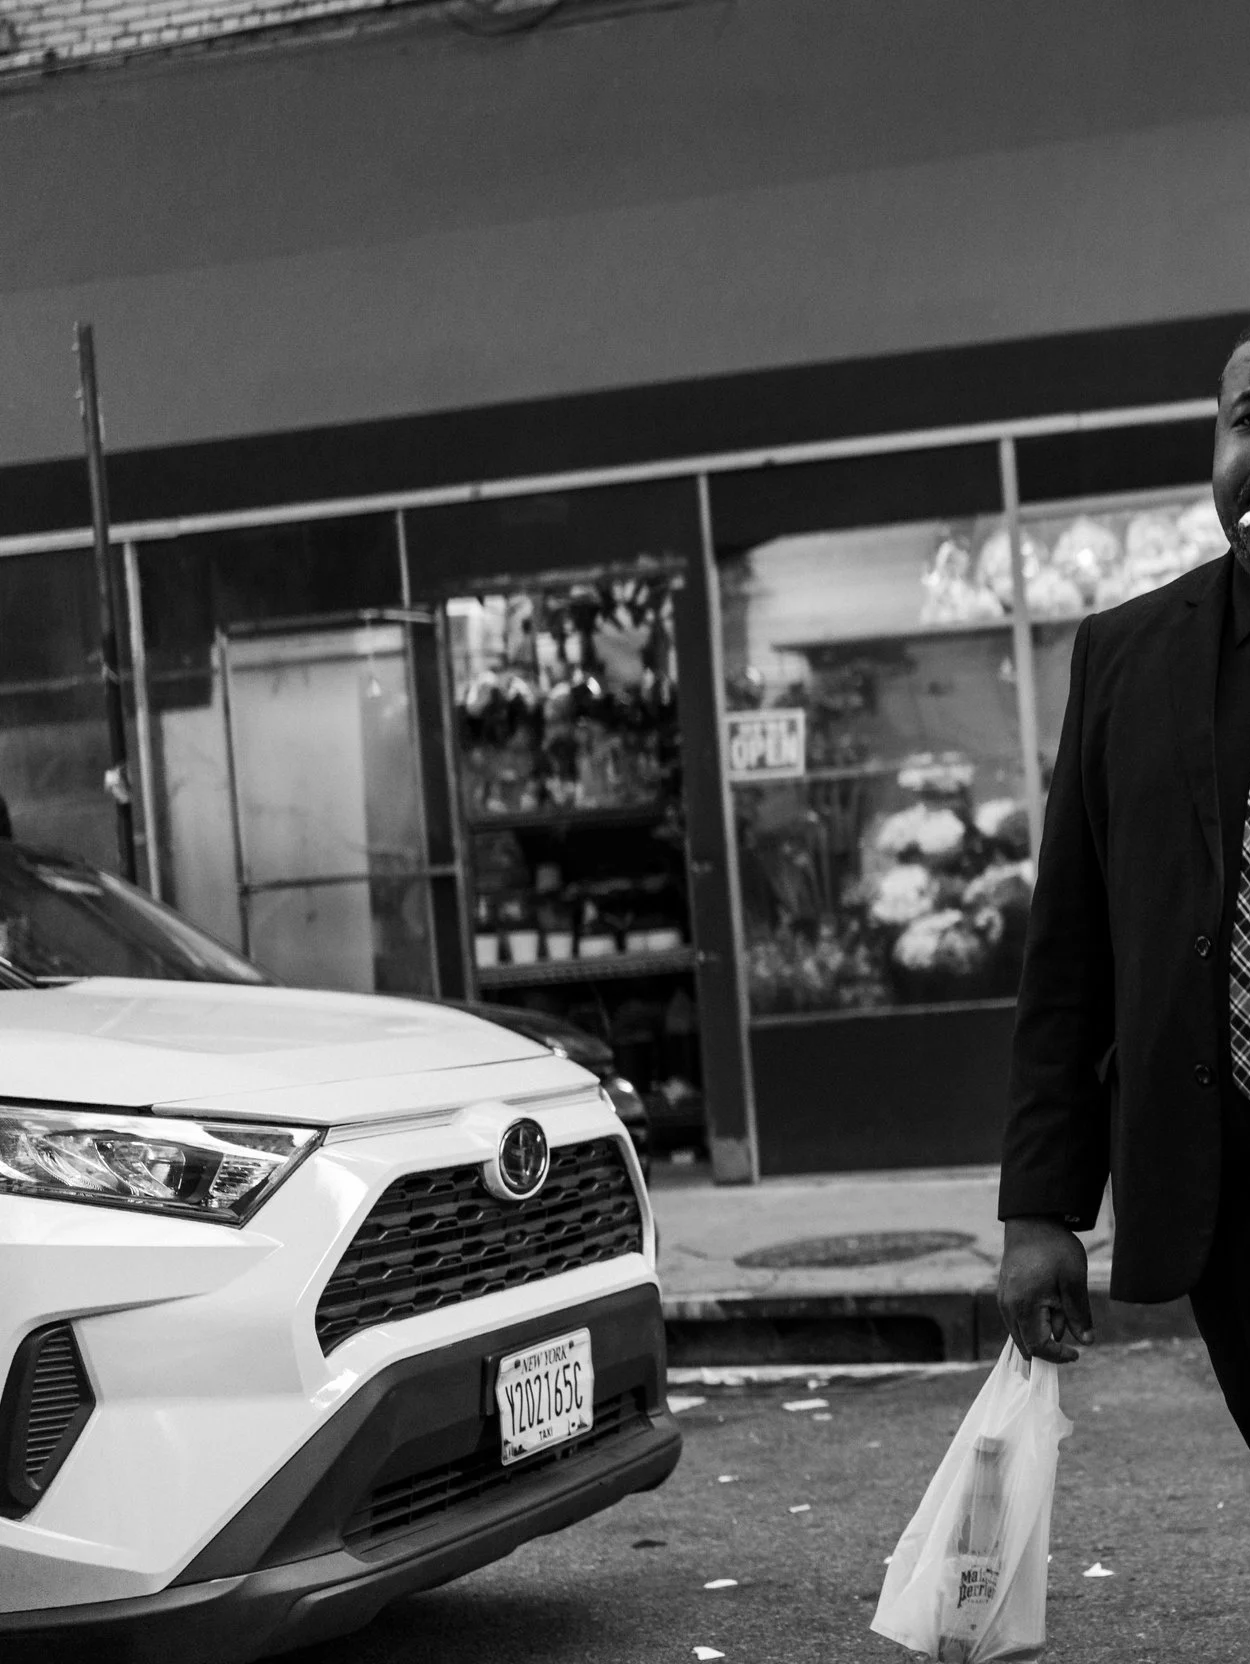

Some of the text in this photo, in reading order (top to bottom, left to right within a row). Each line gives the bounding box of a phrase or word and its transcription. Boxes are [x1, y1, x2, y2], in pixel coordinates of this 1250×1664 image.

[732, 733, 797, 769] OPEN
[522, 1345, 567, 1374] NEW YORK
[505, 1361, 583, 1436] Y202165C
[539, 1427, 553, 1440] TAXI
